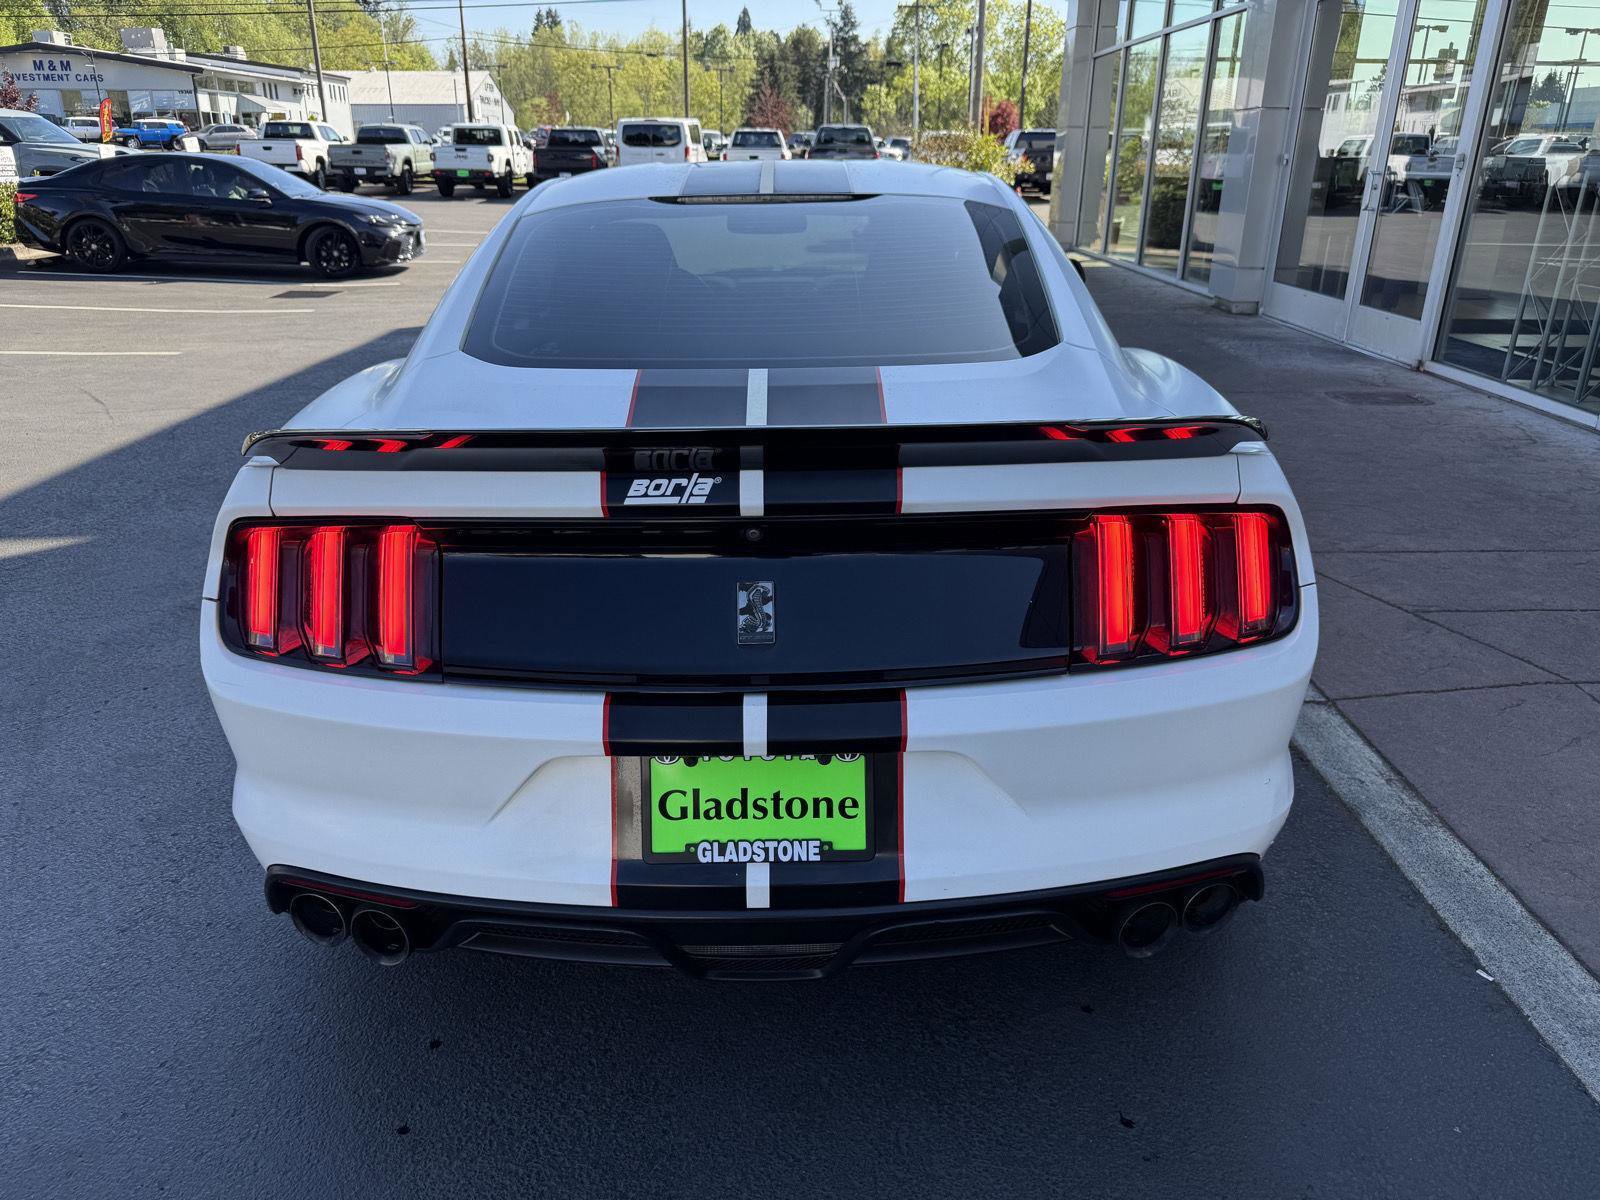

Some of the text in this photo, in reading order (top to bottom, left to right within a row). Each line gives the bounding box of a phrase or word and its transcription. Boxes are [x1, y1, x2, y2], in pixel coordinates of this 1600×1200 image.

[32, 59, 72, 72] M & M
[75, 73, 104, 83] CARS
[658, 788, 860, 821] Gladstone
[697, 841, 821, 863] GLADSTONE
